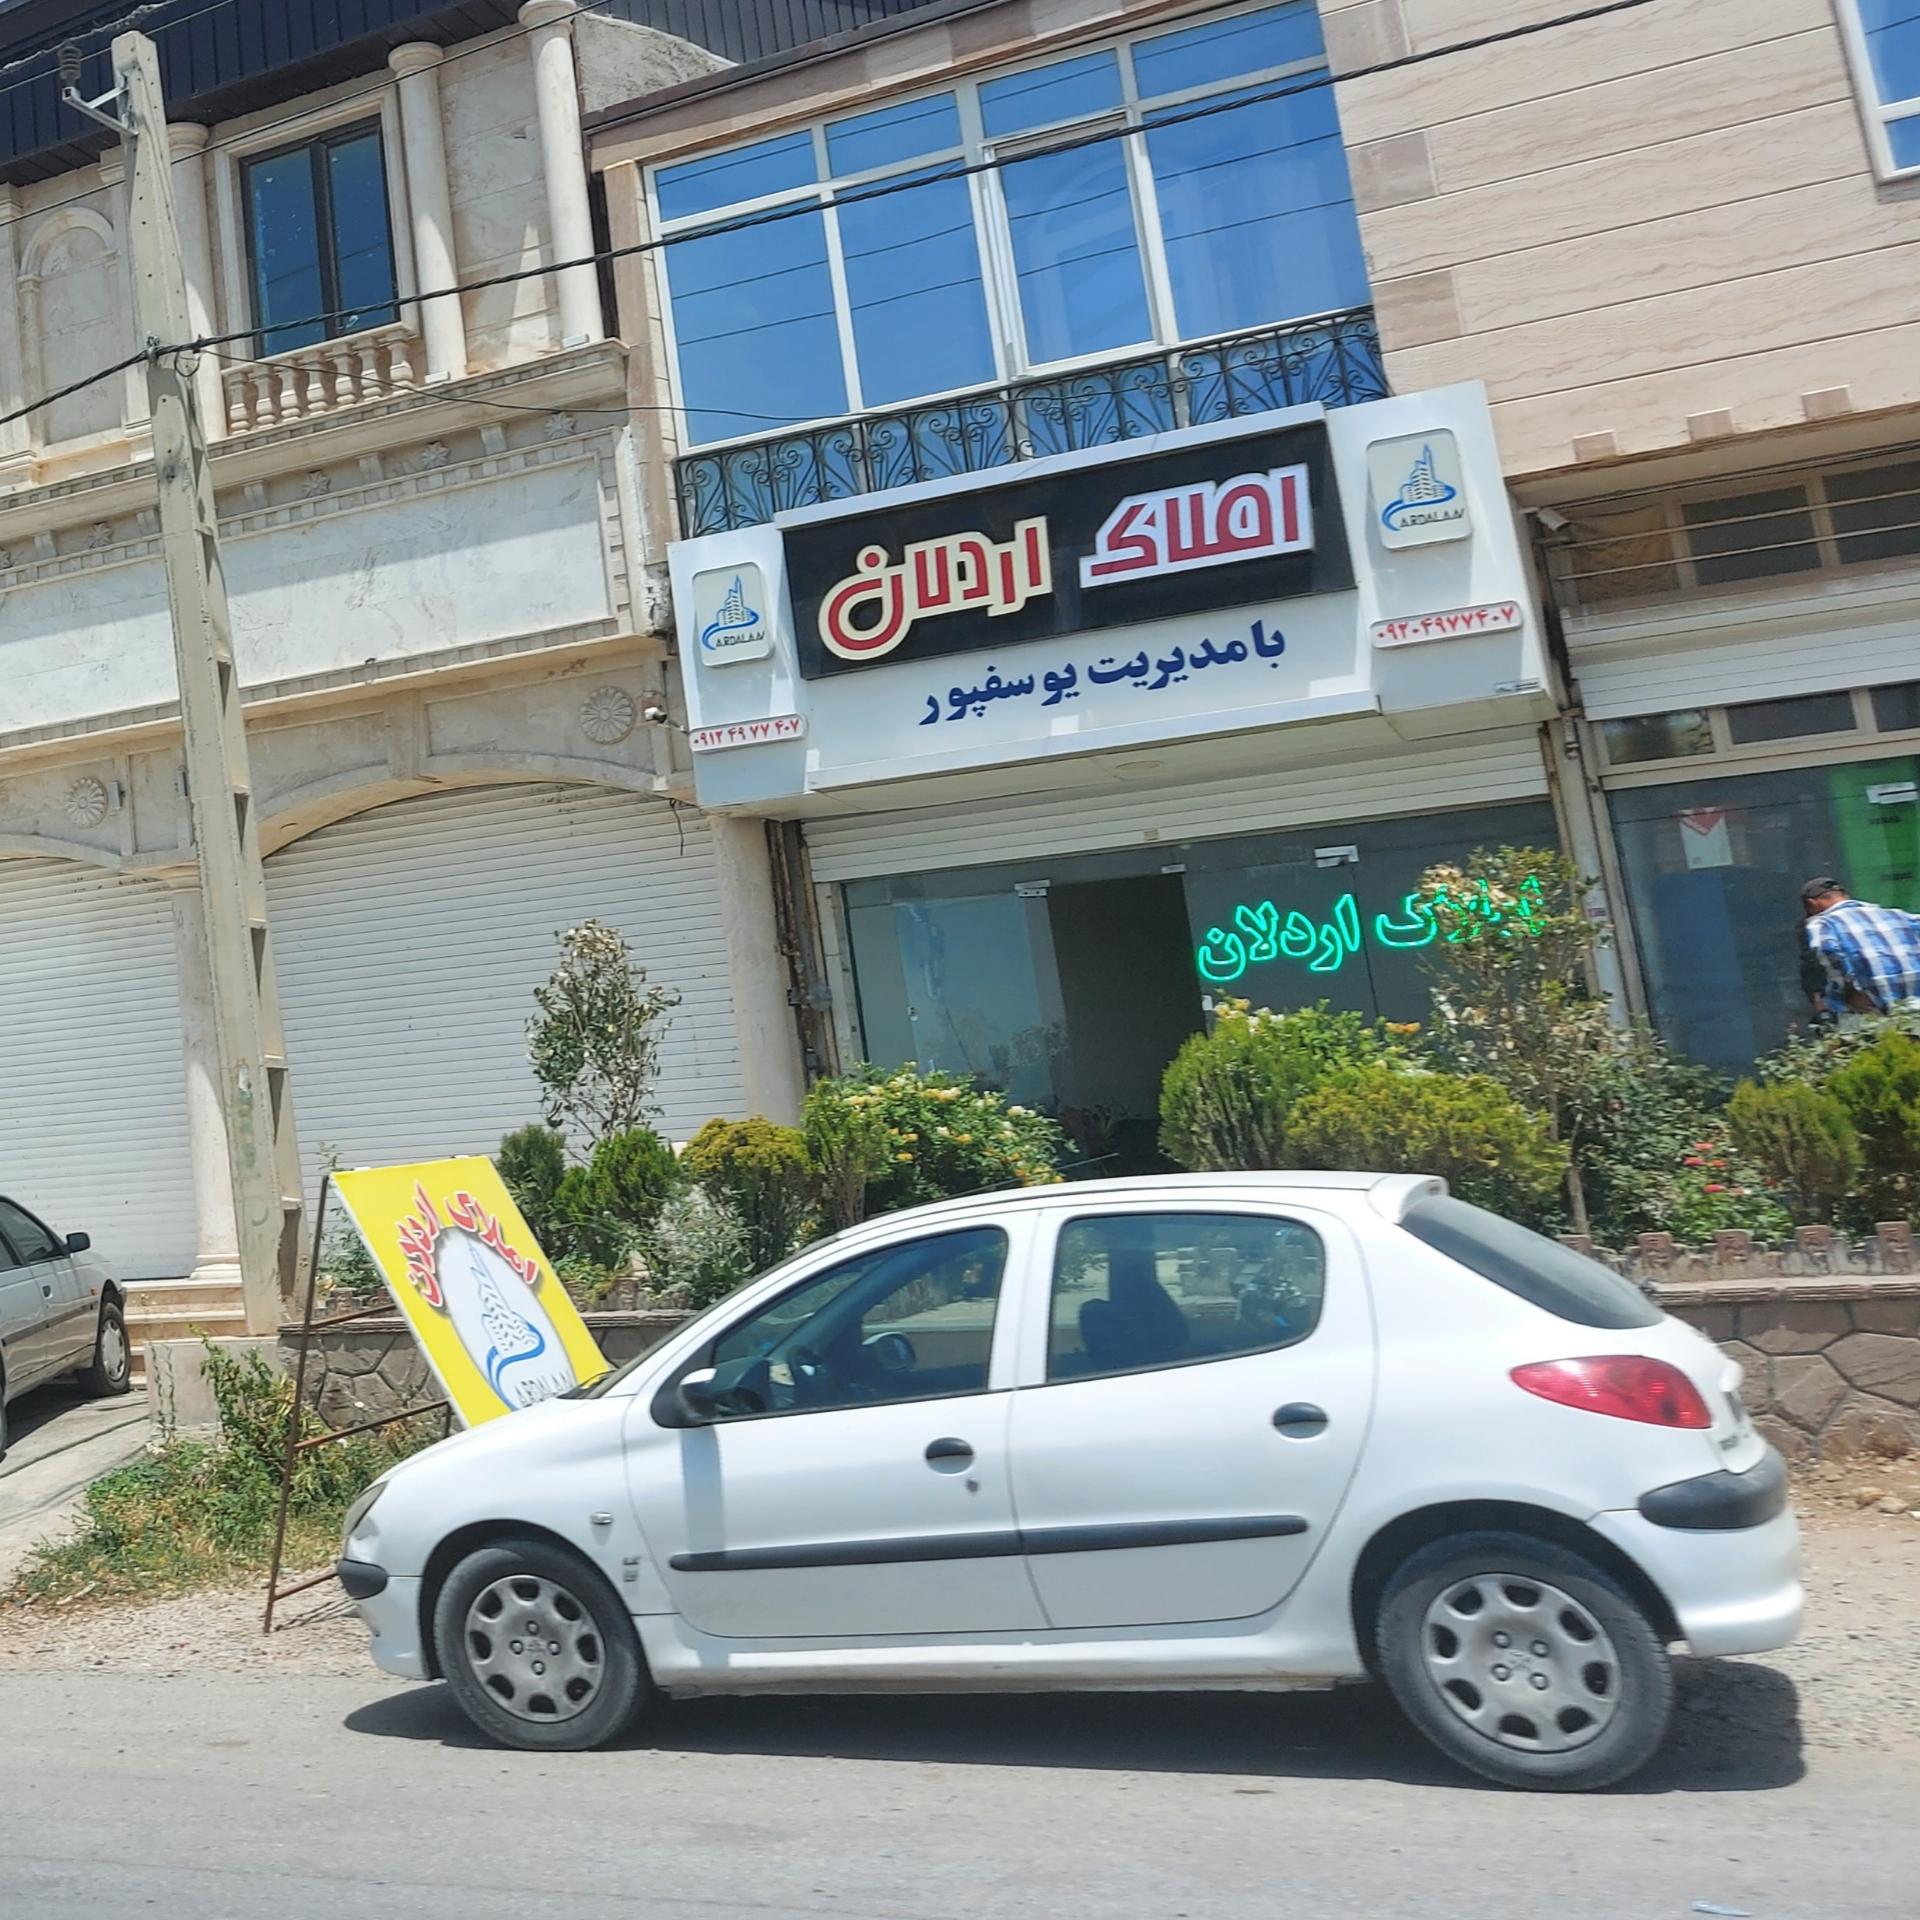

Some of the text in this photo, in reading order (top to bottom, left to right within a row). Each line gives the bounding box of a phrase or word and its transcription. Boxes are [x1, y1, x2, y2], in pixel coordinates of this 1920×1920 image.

[819, 466, 1311, 658] املاک اردلان
[1087, 637, 1248, 690] مدیریت
[1249, 619, 1286, 669] با
[1197, 893, 1362, 981] اردلان
